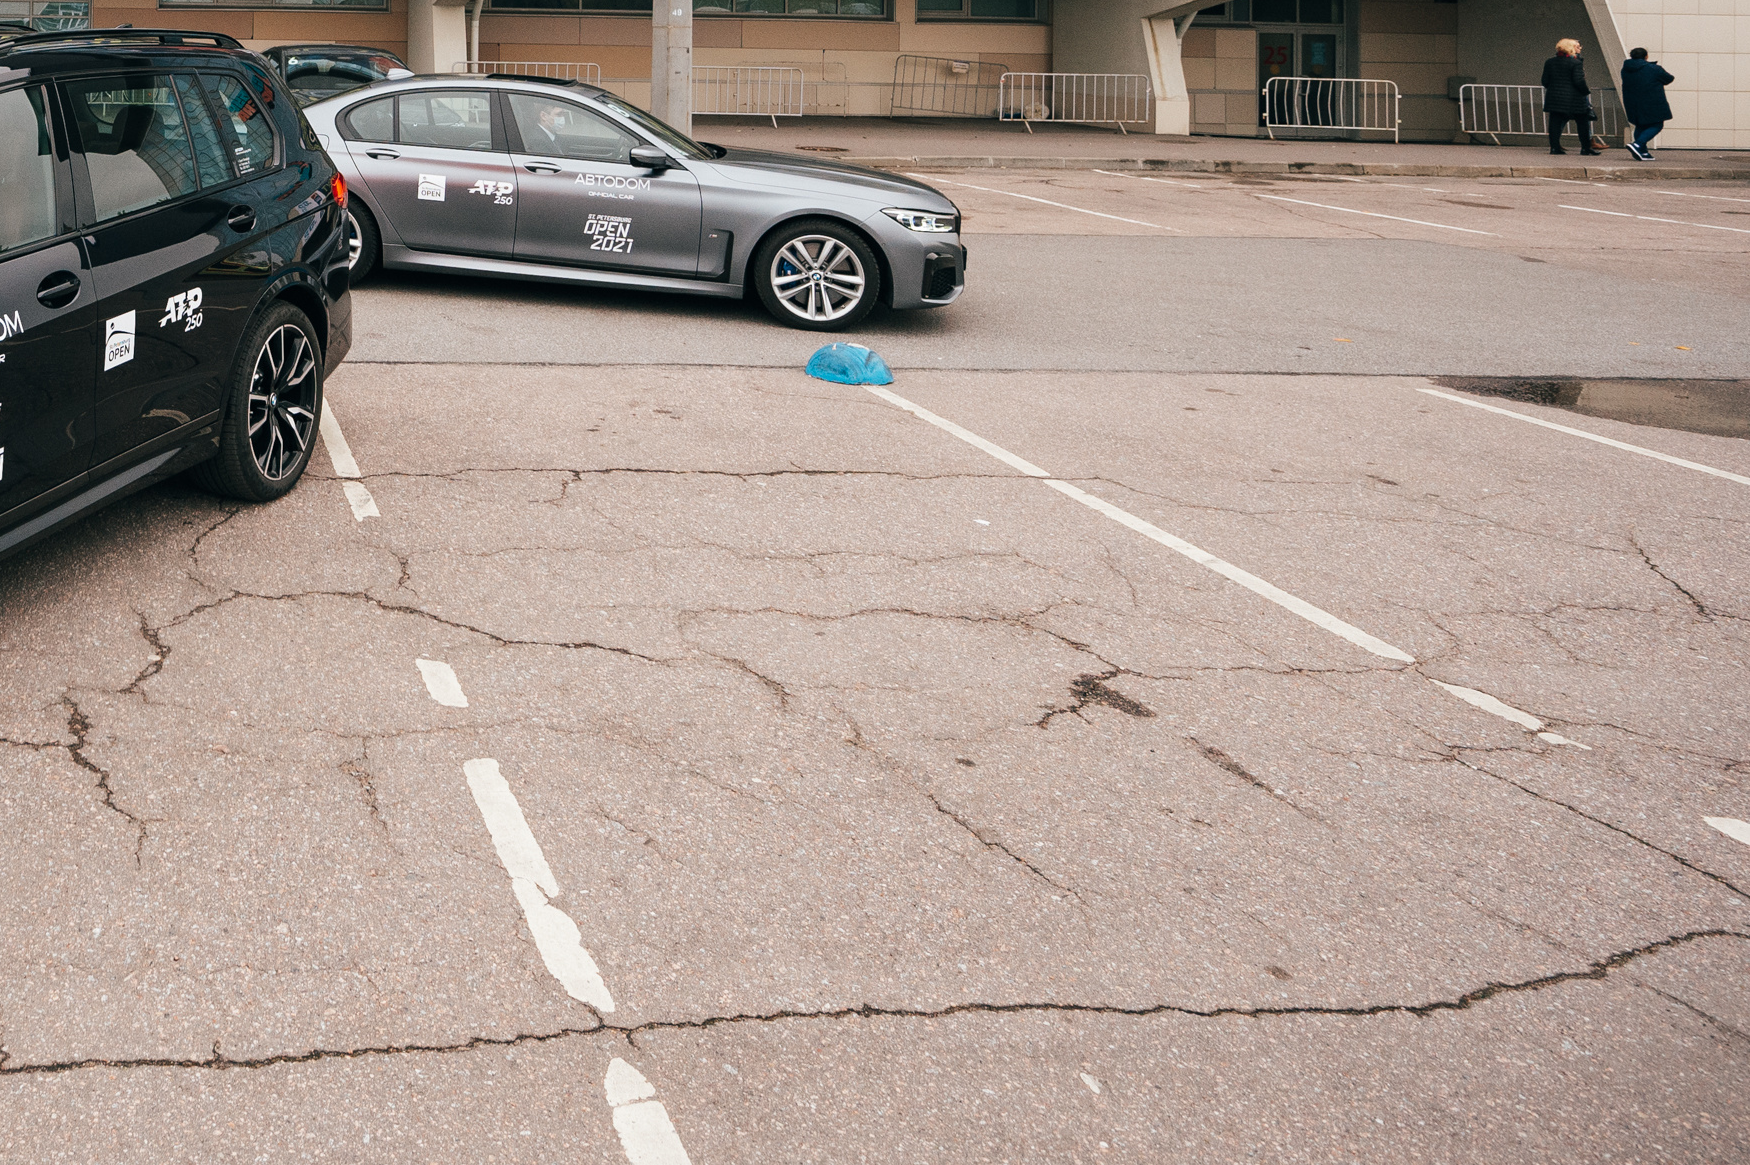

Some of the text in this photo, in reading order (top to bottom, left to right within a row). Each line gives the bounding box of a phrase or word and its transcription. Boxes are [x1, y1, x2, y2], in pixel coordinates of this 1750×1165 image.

[287, 56, 299, 65] 6
[1264, 45, 1289, 65] 25
[420, 189, 441, 197] OPEN
[467, 179, 514, 197] ATP
[493, 196, 513, 205] 250
[583, 220, 631, 238] OPEN
[589, 235, 634, 254] 2021
[158, 286, 203, 327] ATP
[184, 312, 203, 333] 250
[108, 344, 130, 362] OPEN
